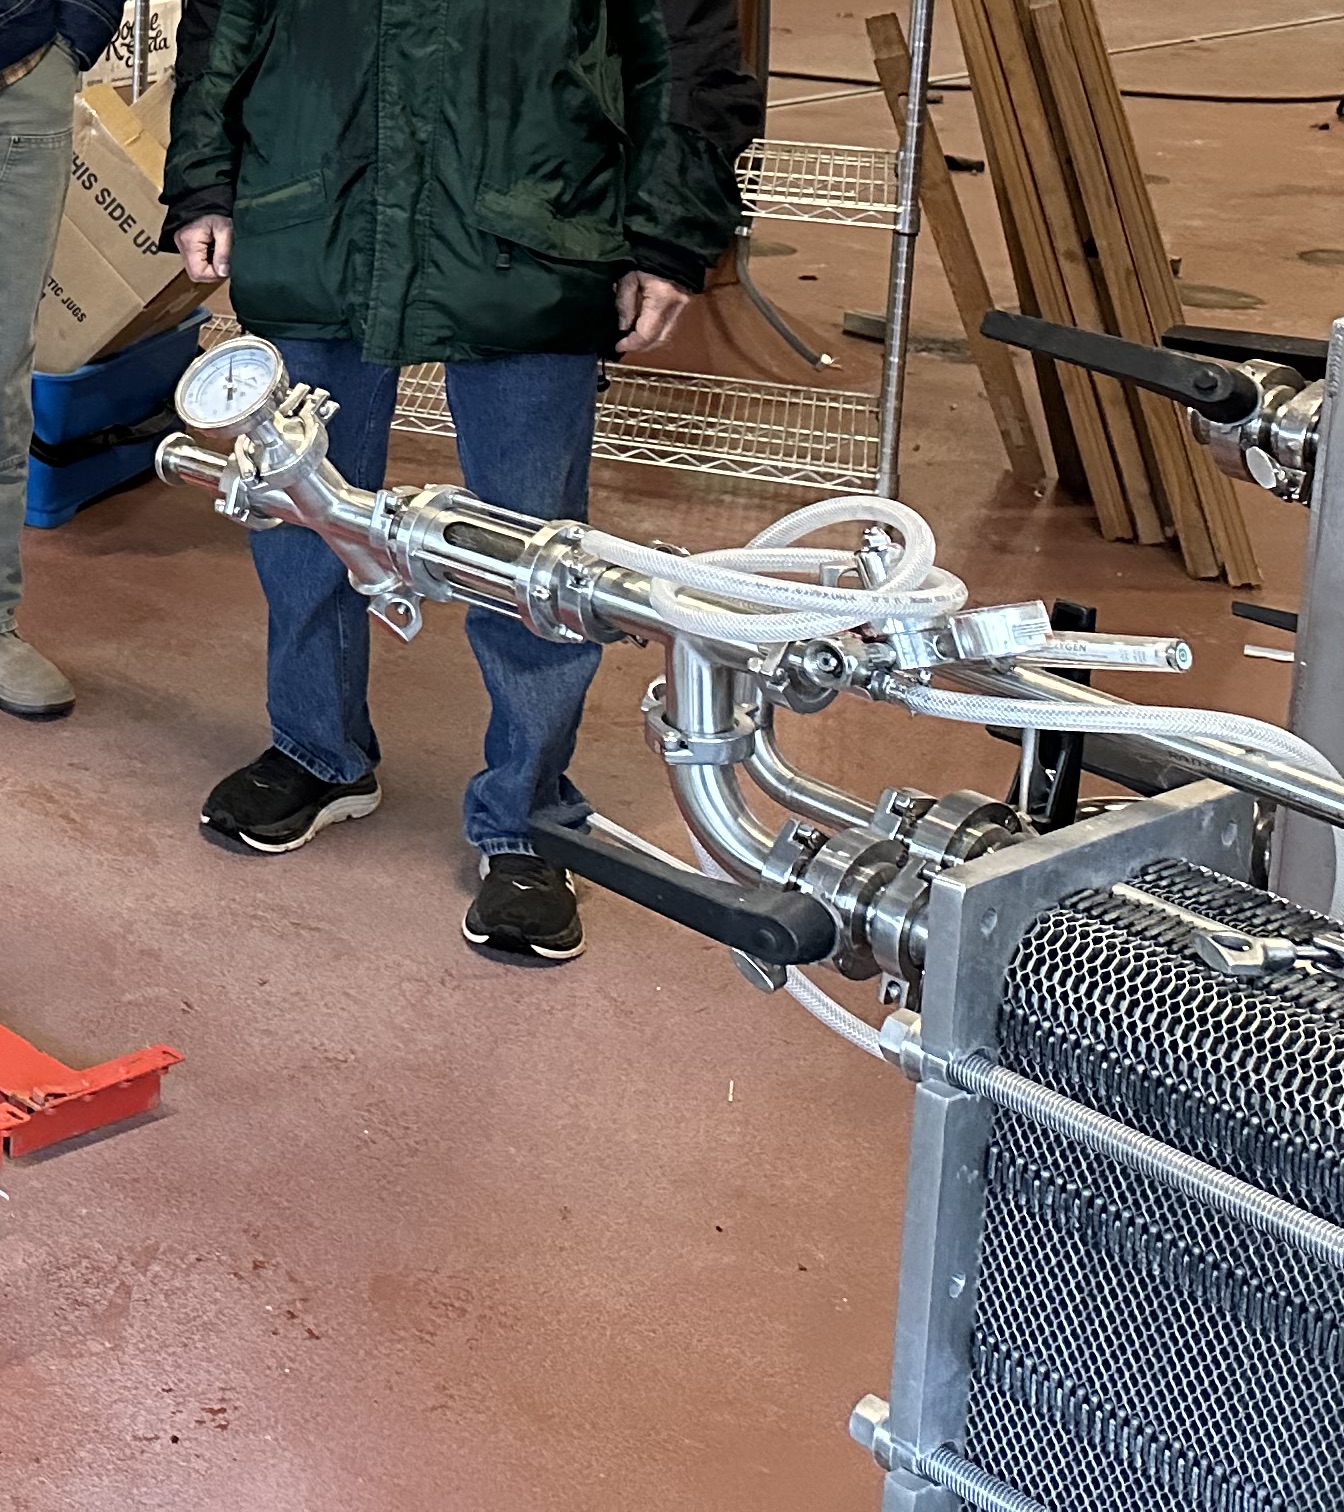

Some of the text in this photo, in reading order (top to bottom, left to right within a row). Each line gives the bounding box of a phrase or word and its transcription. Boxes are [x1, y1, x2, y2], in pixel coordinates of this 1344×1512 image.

[72, 152, 161, 256] HIS SIDE UP
[61, 295, 87, 323] JUGS
